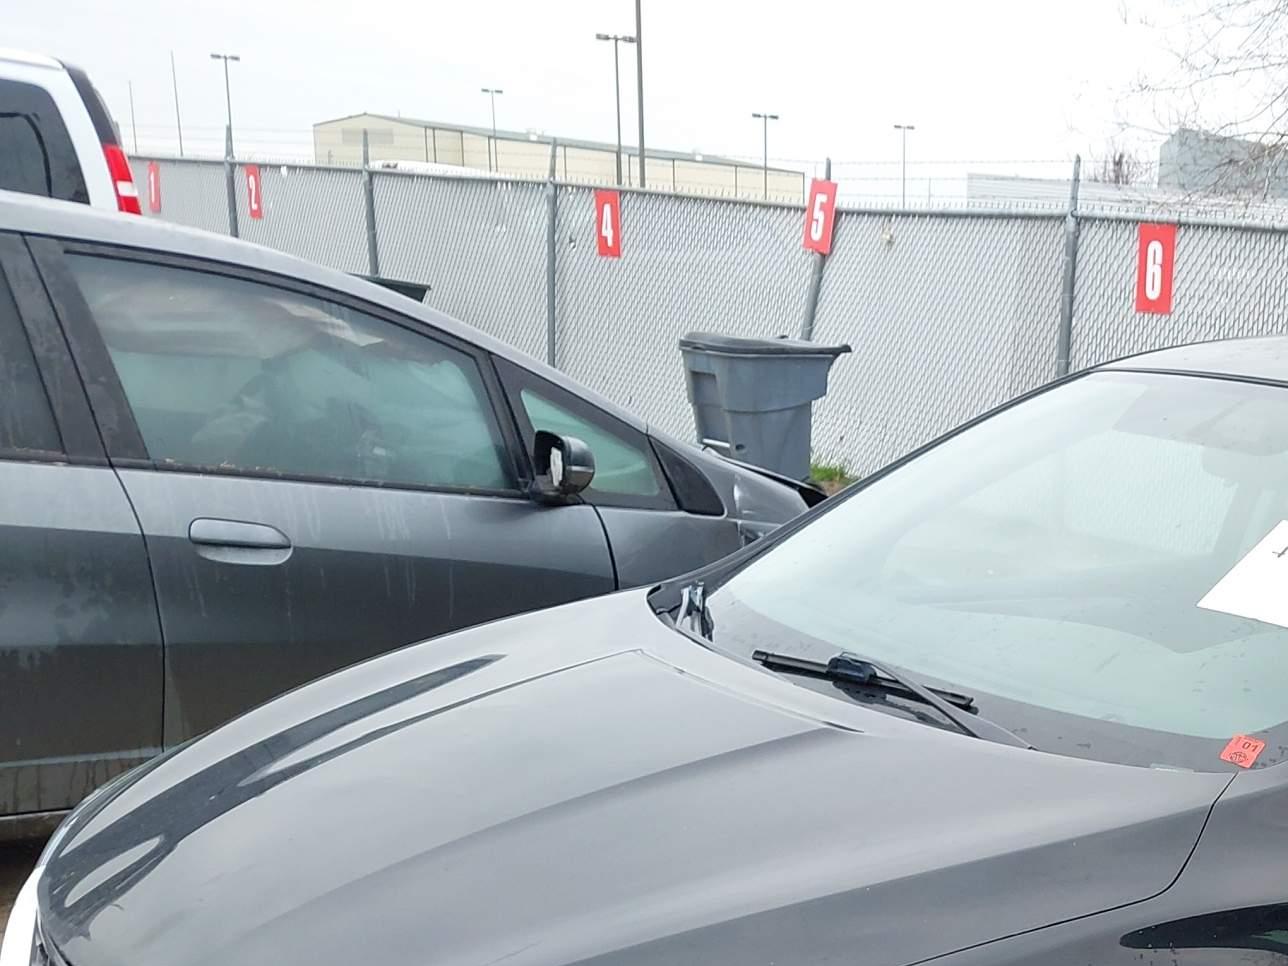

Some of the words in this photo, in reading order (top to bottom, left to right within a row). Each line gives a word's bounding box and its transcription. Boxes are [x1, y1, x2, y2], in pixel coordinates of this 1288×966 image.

[150, 171, 156, 204] 1
[248, 174, 258, 210] 2
[601, 203, 614, 248] 4
[810, 192, 828, 242] 5
[1145, 240, 1163, 300] 6
